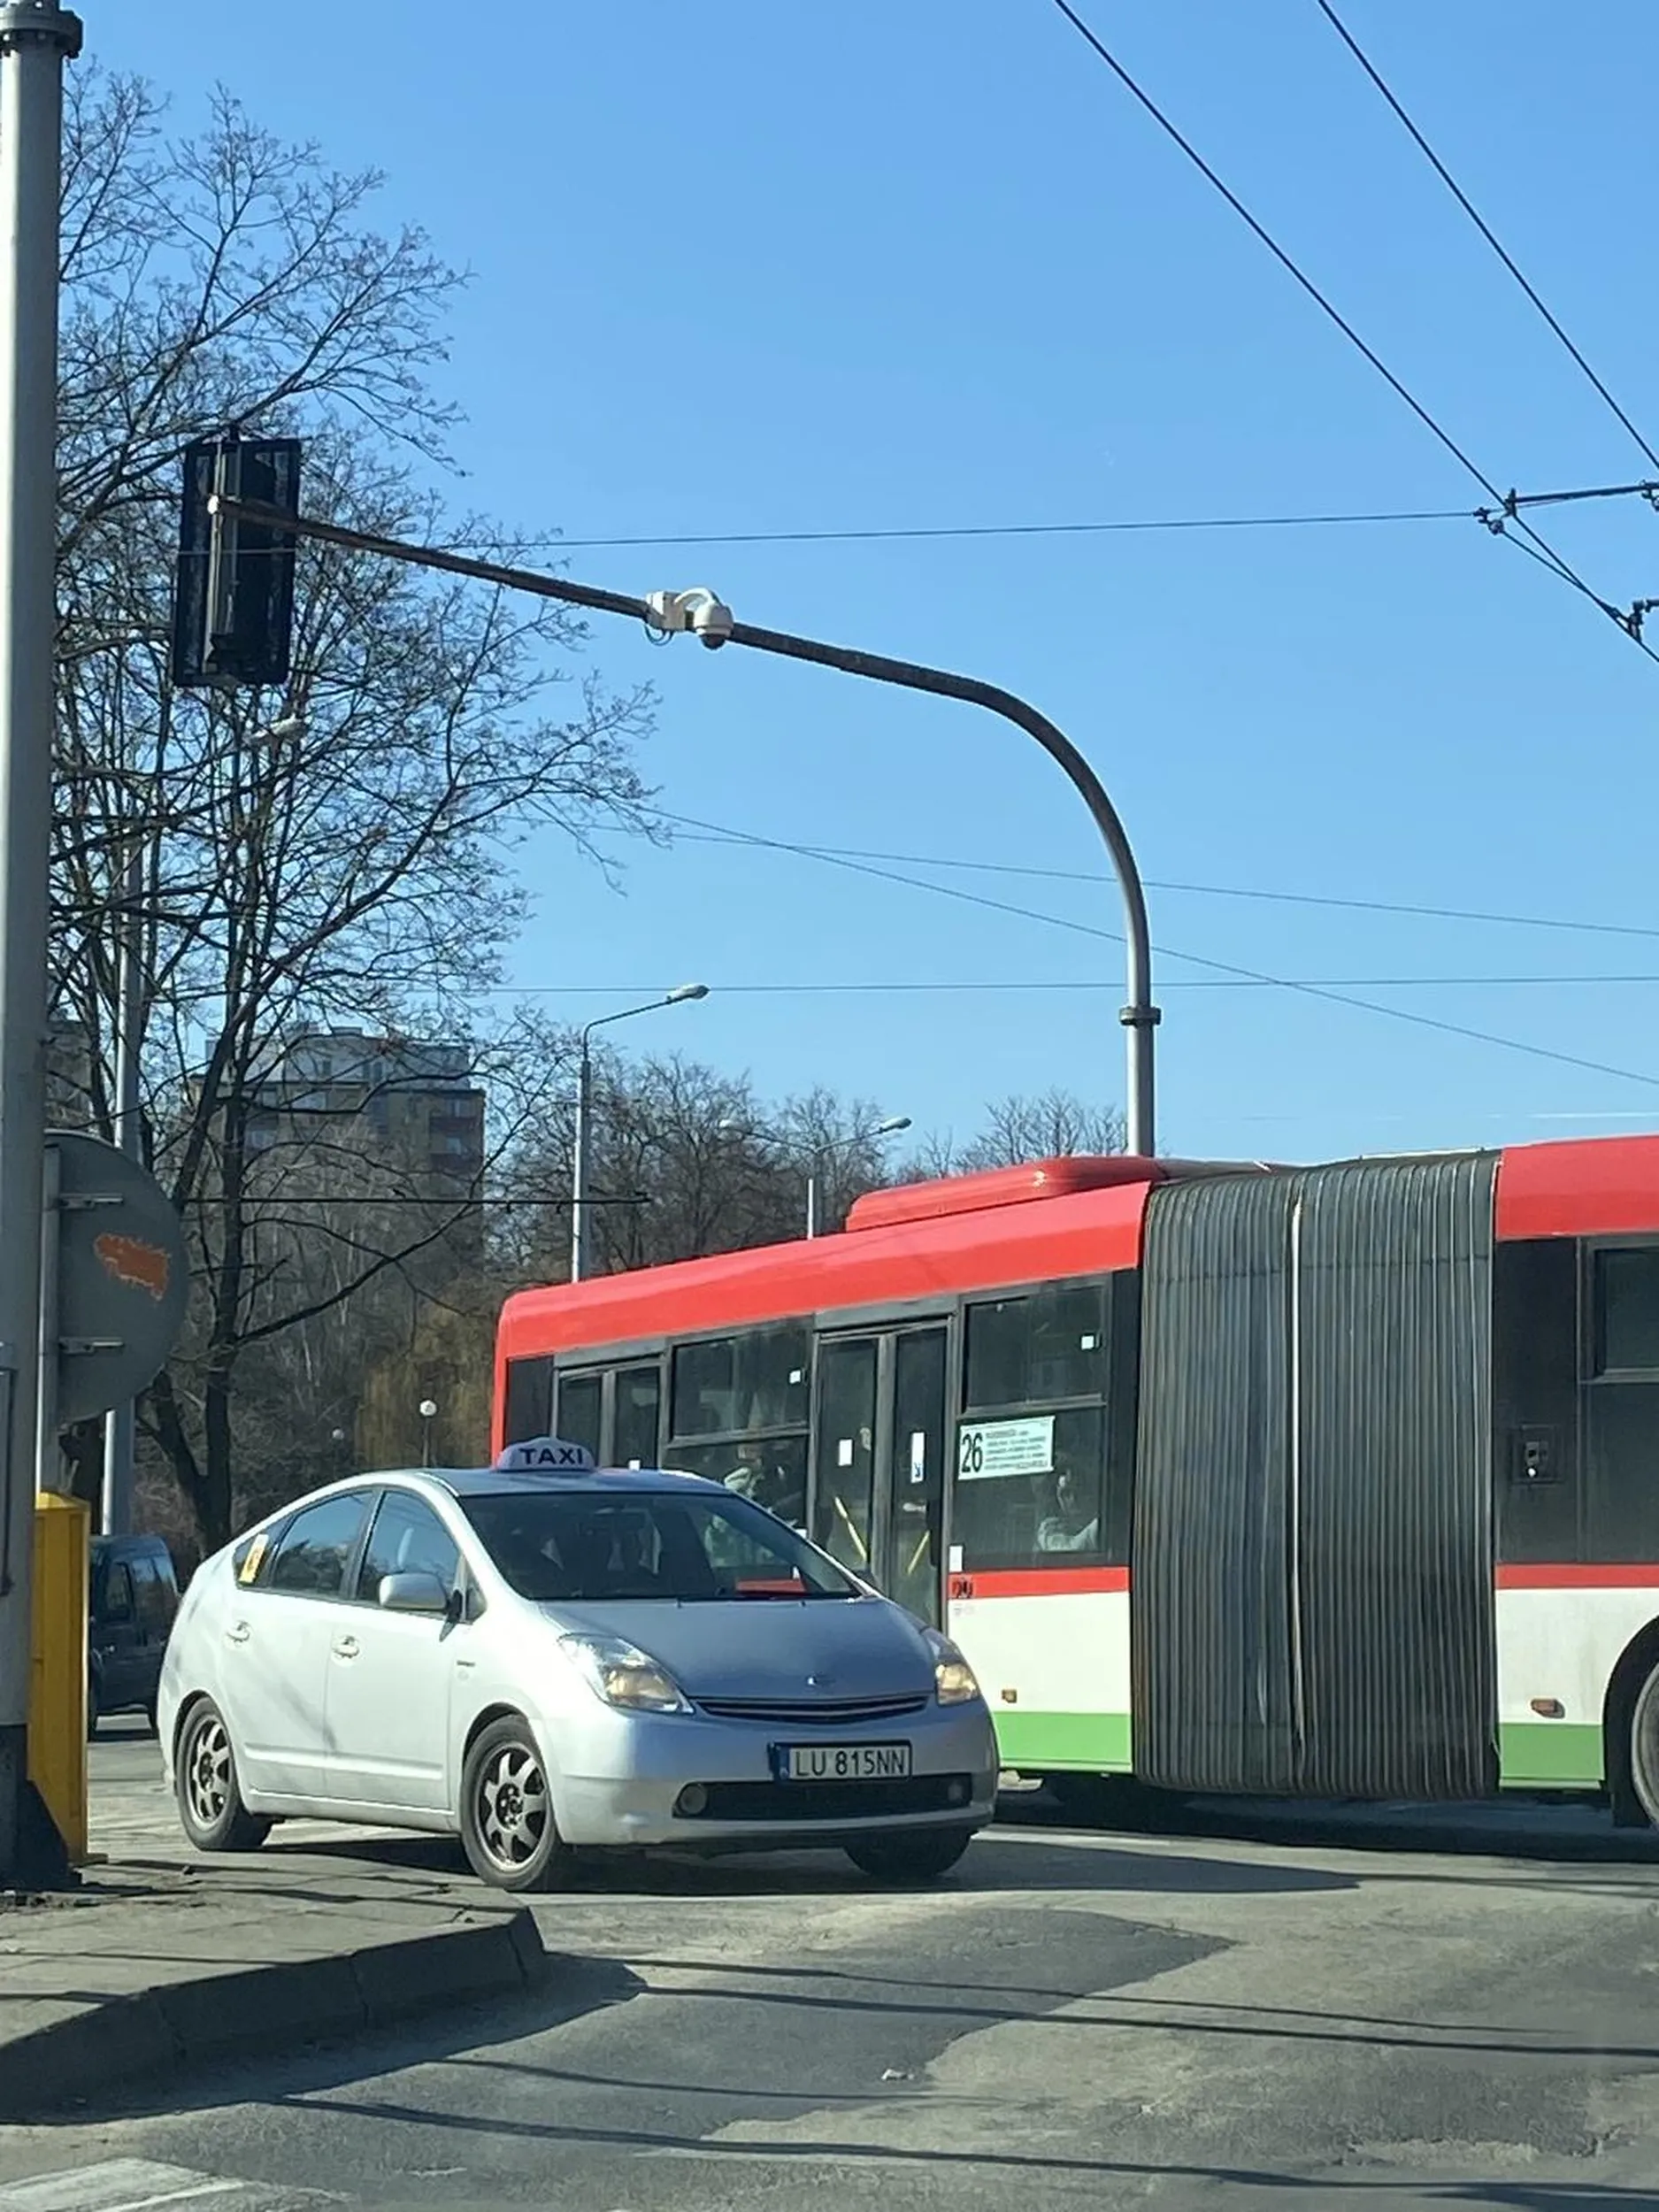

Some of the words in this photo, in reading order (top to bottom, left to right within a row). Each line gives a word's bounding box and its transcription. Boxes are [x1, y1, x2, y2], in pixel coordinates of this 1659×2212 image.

[519, 1448, 583, 1464] TAXI
[961, 1432, 983, 1472] 26
[795, 1751, 826, 1777] LU
[835, 1749, 904, 1776] 815NN
